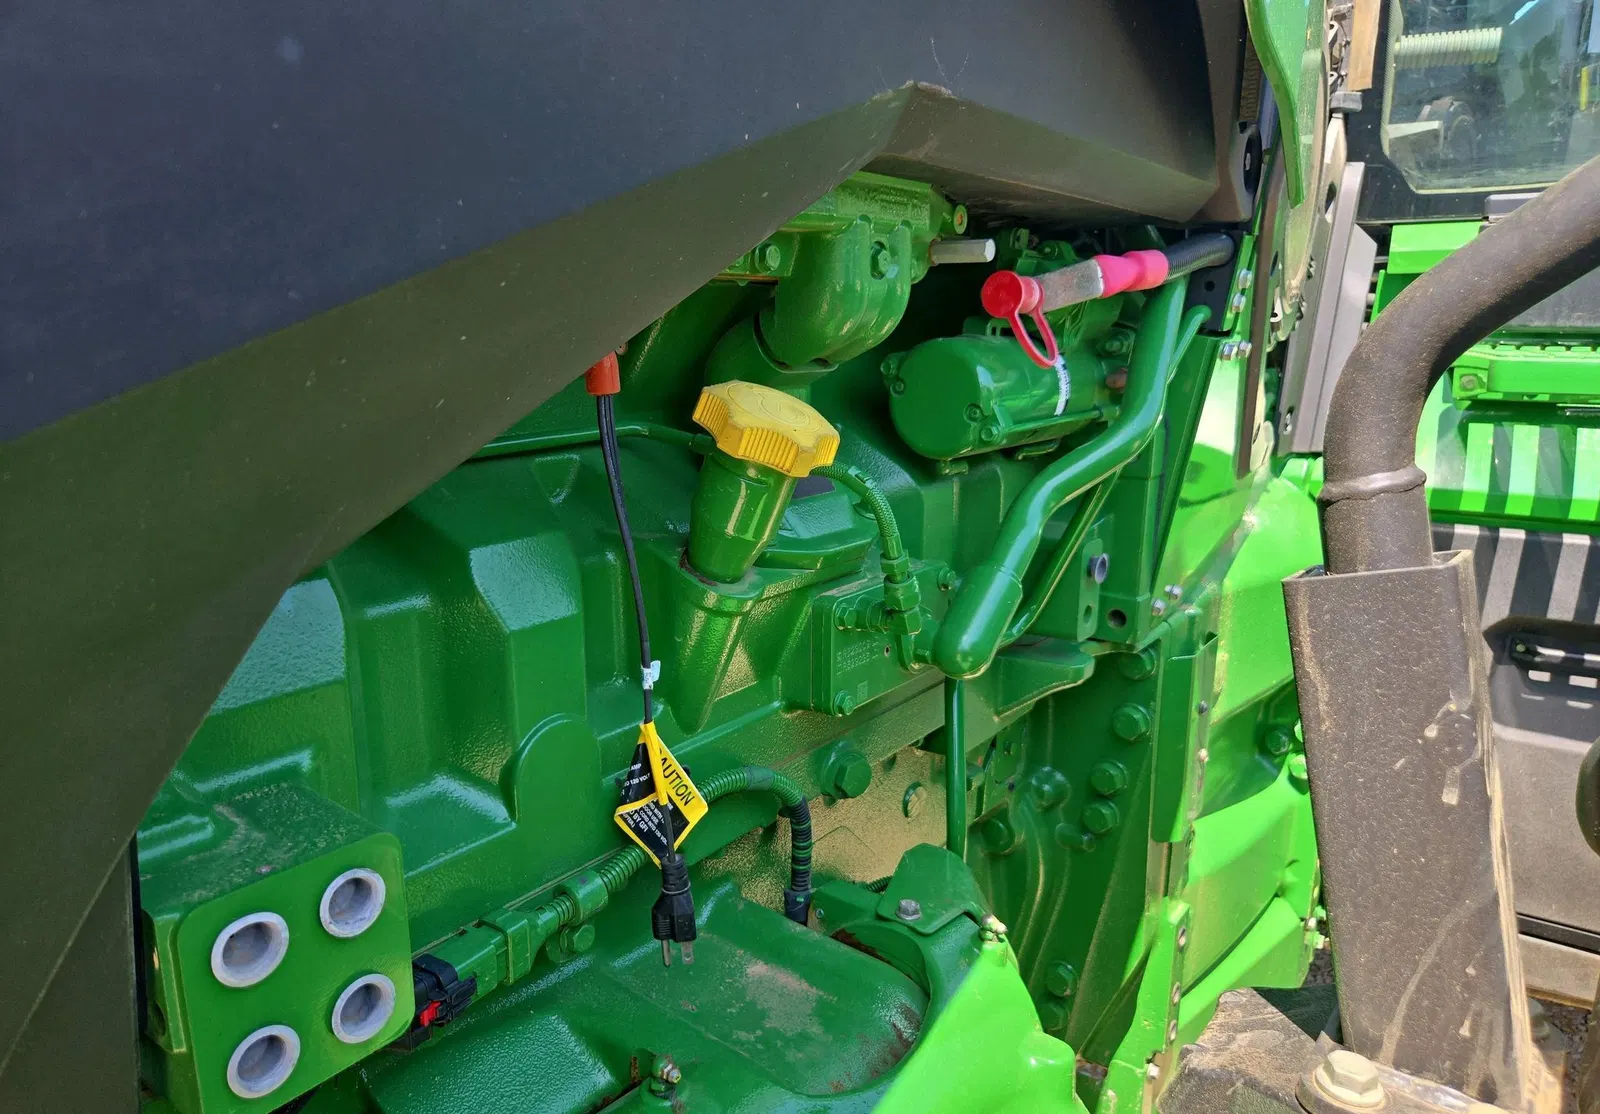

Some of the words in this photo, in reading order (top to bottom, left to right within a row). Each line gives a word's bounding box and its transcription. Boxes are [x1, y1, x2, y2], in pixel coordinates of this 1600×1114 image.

[660, 748, 695, 806] AUTION
[632, 812, 642, 823] BY
[638, 820, 649, 833] GFI
